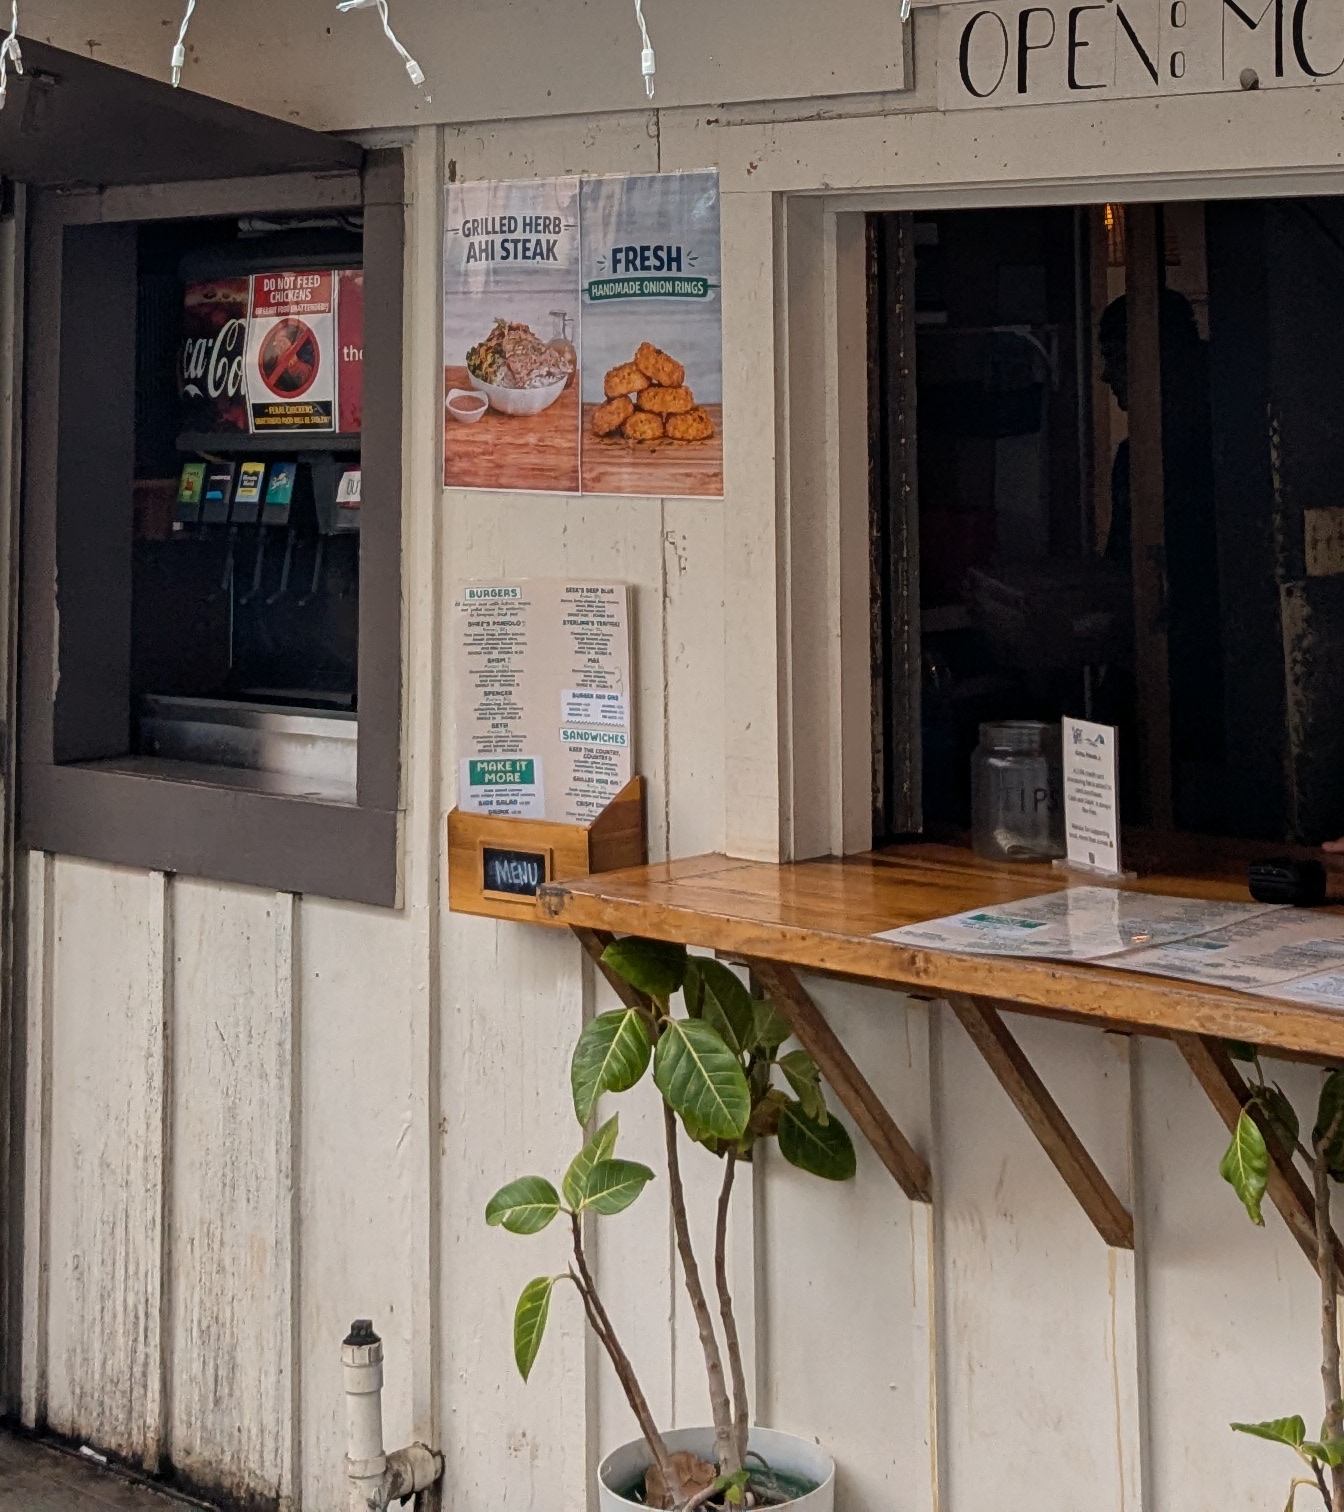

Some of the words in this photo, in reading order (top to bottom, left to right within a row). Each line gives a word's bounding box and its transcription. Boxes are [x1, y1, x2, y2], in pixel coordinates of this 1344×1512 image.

[462, 216, 518, 238] GRILLED
[522, 216, 562, 235] HERB
[466, 239, 496, 264] AHI
[500, 238, 559, 262] STEAK
[611, 245, 683, 274] FRESH
[264, 279, 276, 291] DO
[277, 276, 295, 290] NOT
[297, 275, 321, 288] FEED
[591, 281, 641, 297] HANDMADE
[643, 280, 673, 295] ONION
[674, 280, 704, 295] RINGS
[270, 289, 312, 303] CHICKENS
[469, 588, 518, 599] BURGERS
[562, 730, 626, 745] SANDWICHES
[477, 760, 513, 773] MAKE
[516, 760, 528, 772] IT
[484, 772, 522, 783] MORE
[495, 859, 538, 886] MENU
